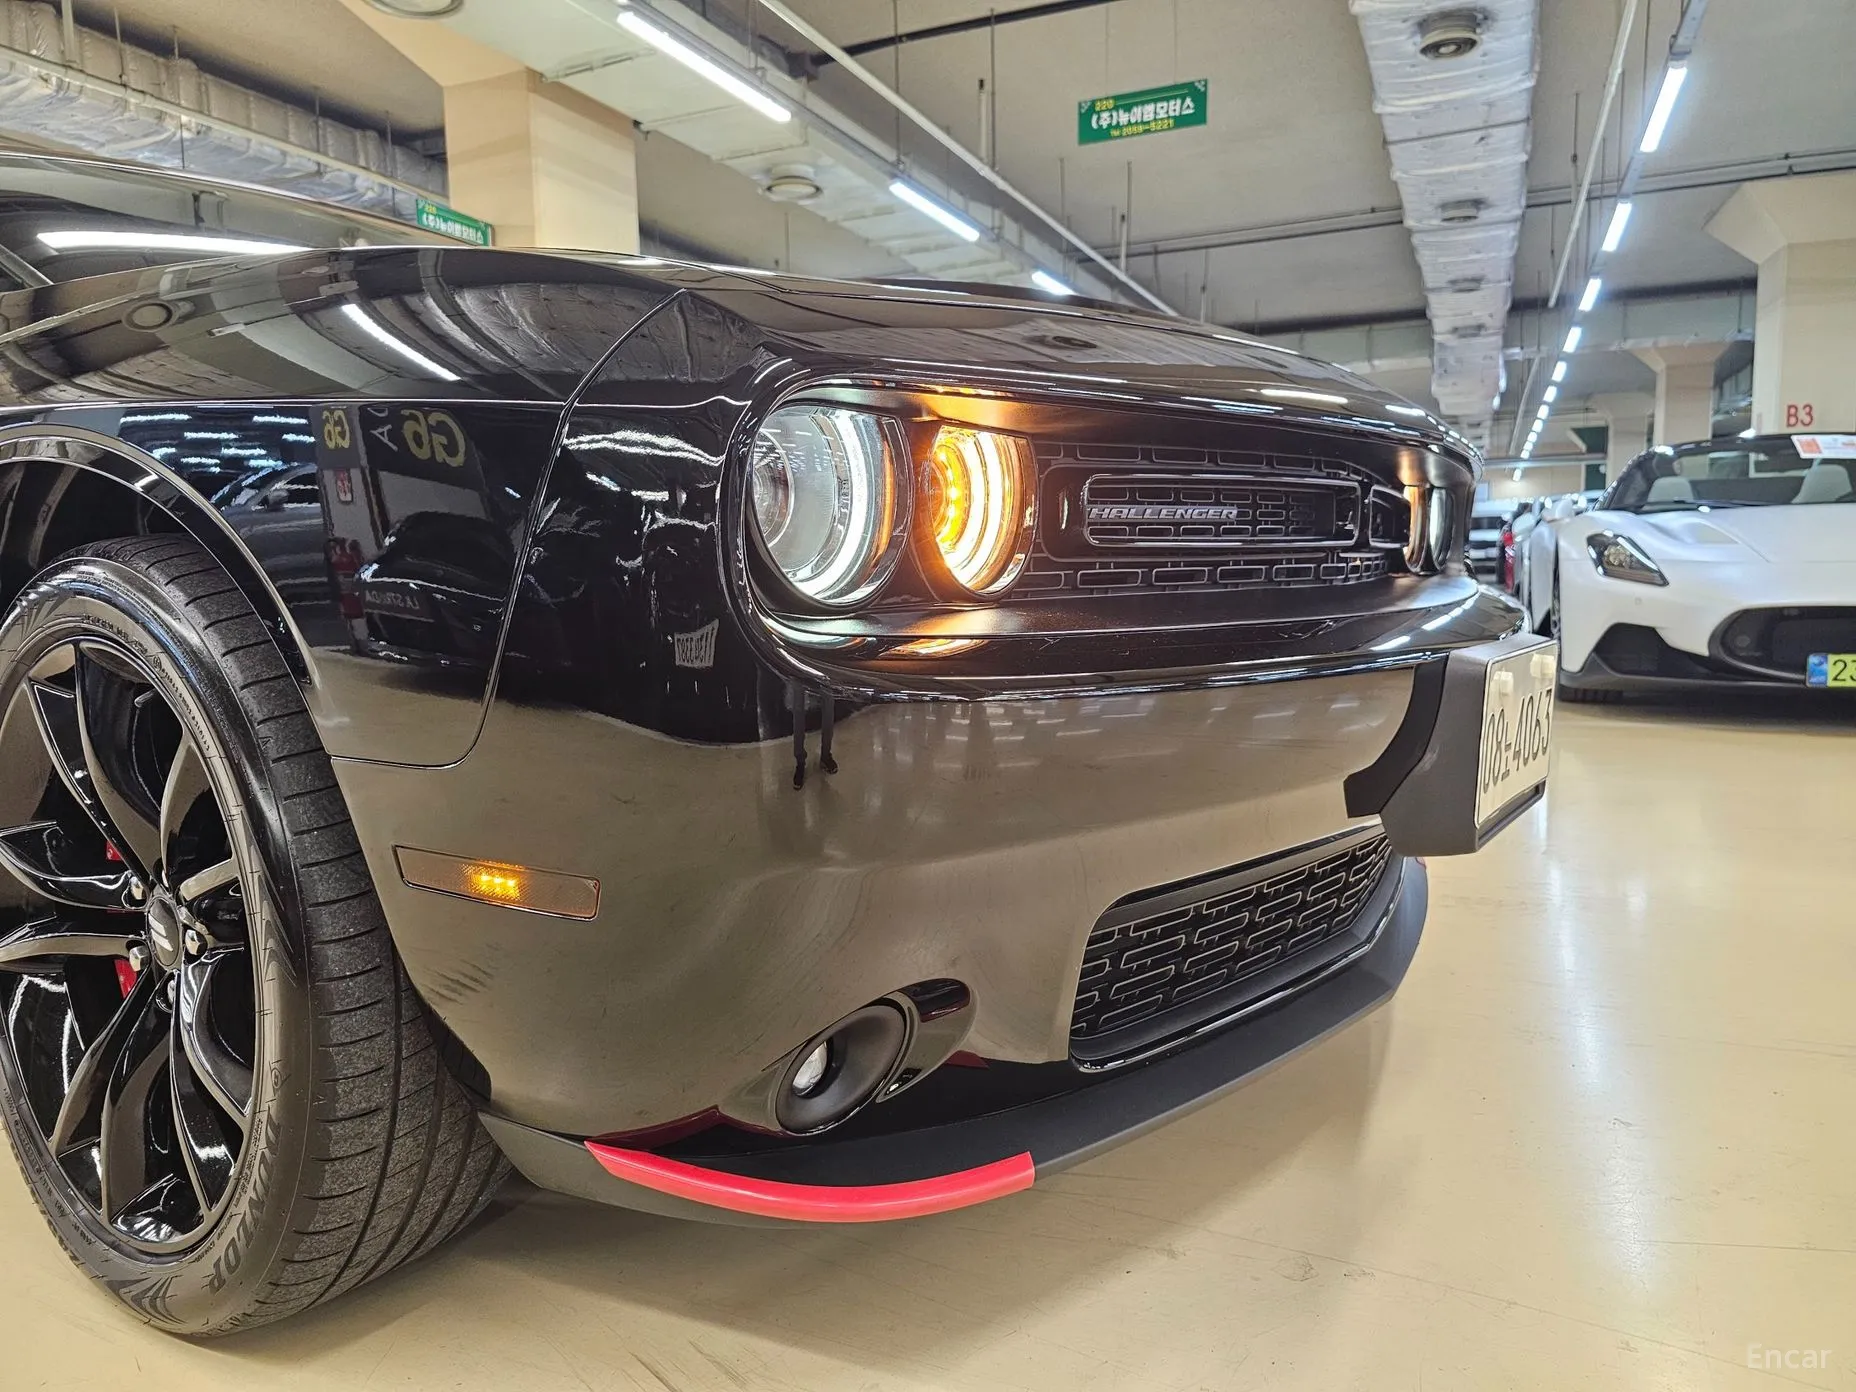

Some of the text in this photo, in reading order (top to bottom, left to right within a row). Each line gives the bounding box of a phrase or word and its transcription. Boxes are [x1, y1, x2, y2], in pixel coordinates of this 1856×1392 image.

[1786, 404, 1814, 428] B3
[1087, 507, 1238, 520] HALLENGER
[1483, 688, 1552, 794] 08노4063
[208, 1105, 284, 1295] DUNLOP
